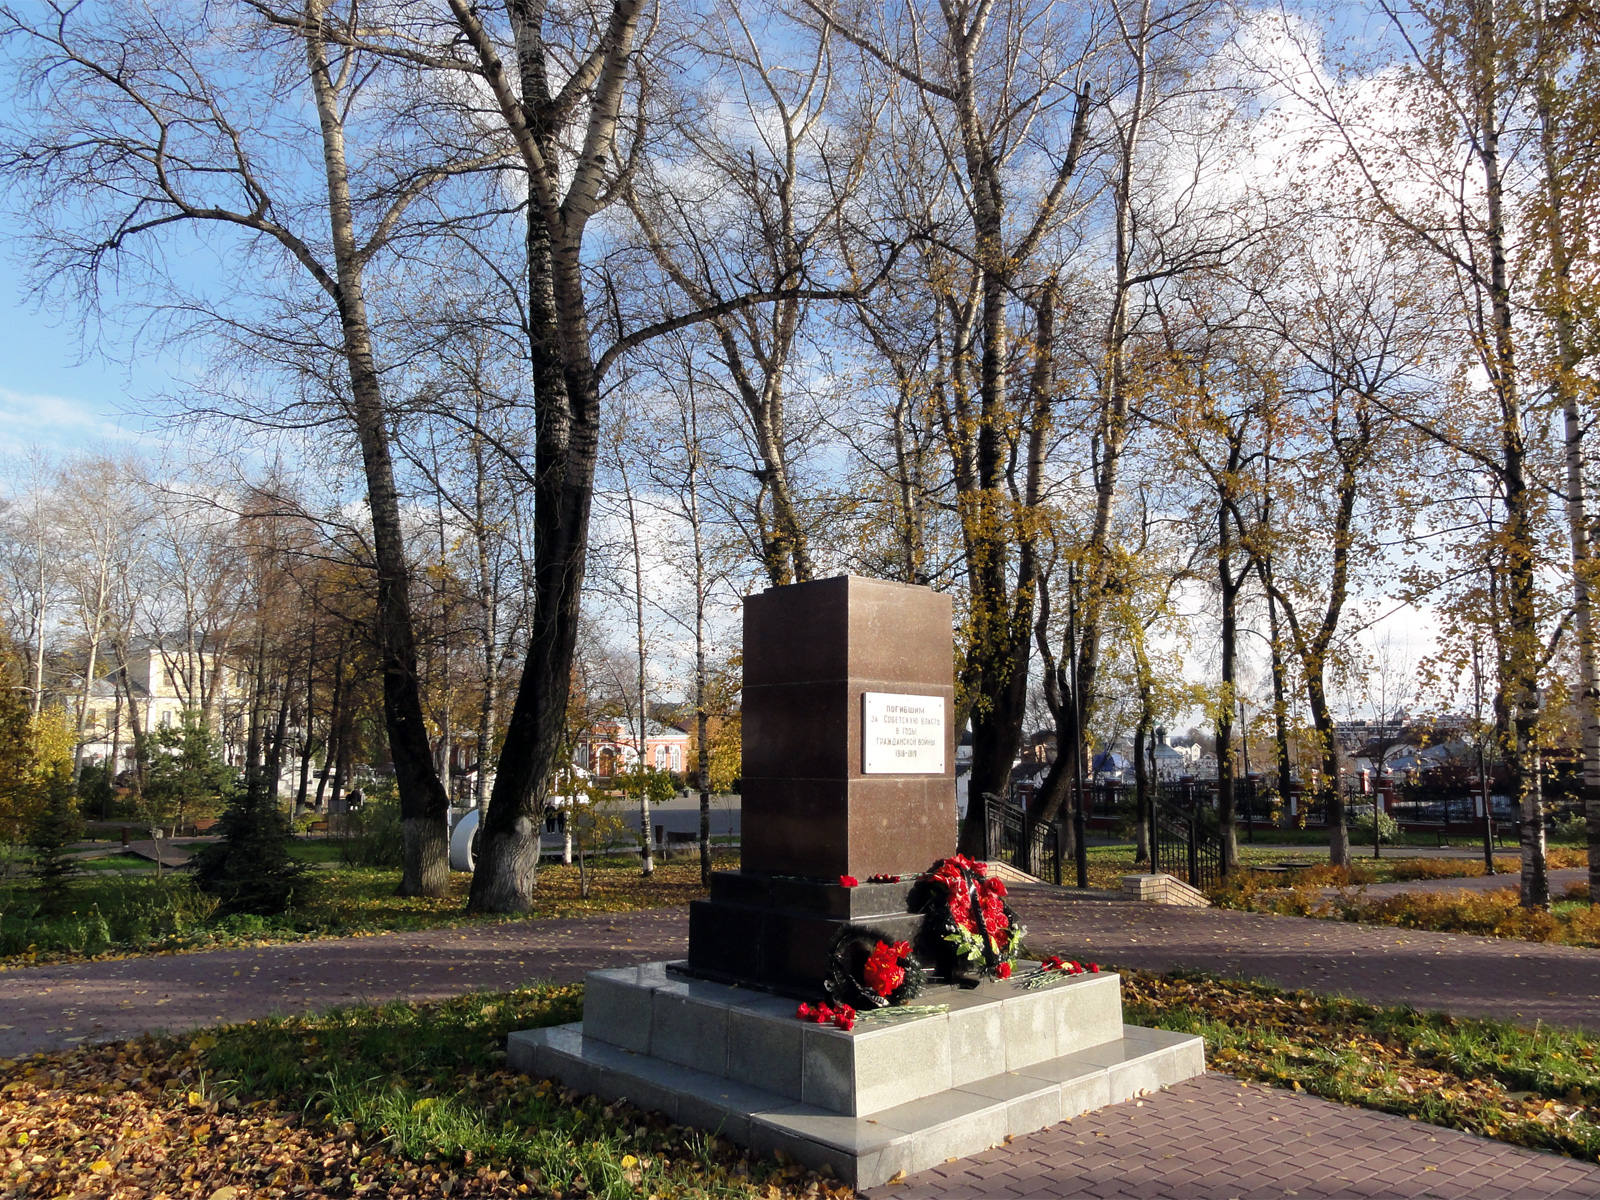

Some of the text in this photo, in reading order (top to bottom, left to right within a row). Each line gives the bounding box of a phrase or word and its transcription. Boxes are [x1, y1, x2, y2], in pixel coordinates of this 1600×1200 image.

[886, 705, 925, 714] ПОГИБШИМ
[920, 717, 941, 726] ВЛАСТЬ
[902, 727, 917, 735] ГОДЫ
[876, 736, 936, 746] ГРАЖДАНСКОЙ ВОЙНЫ
